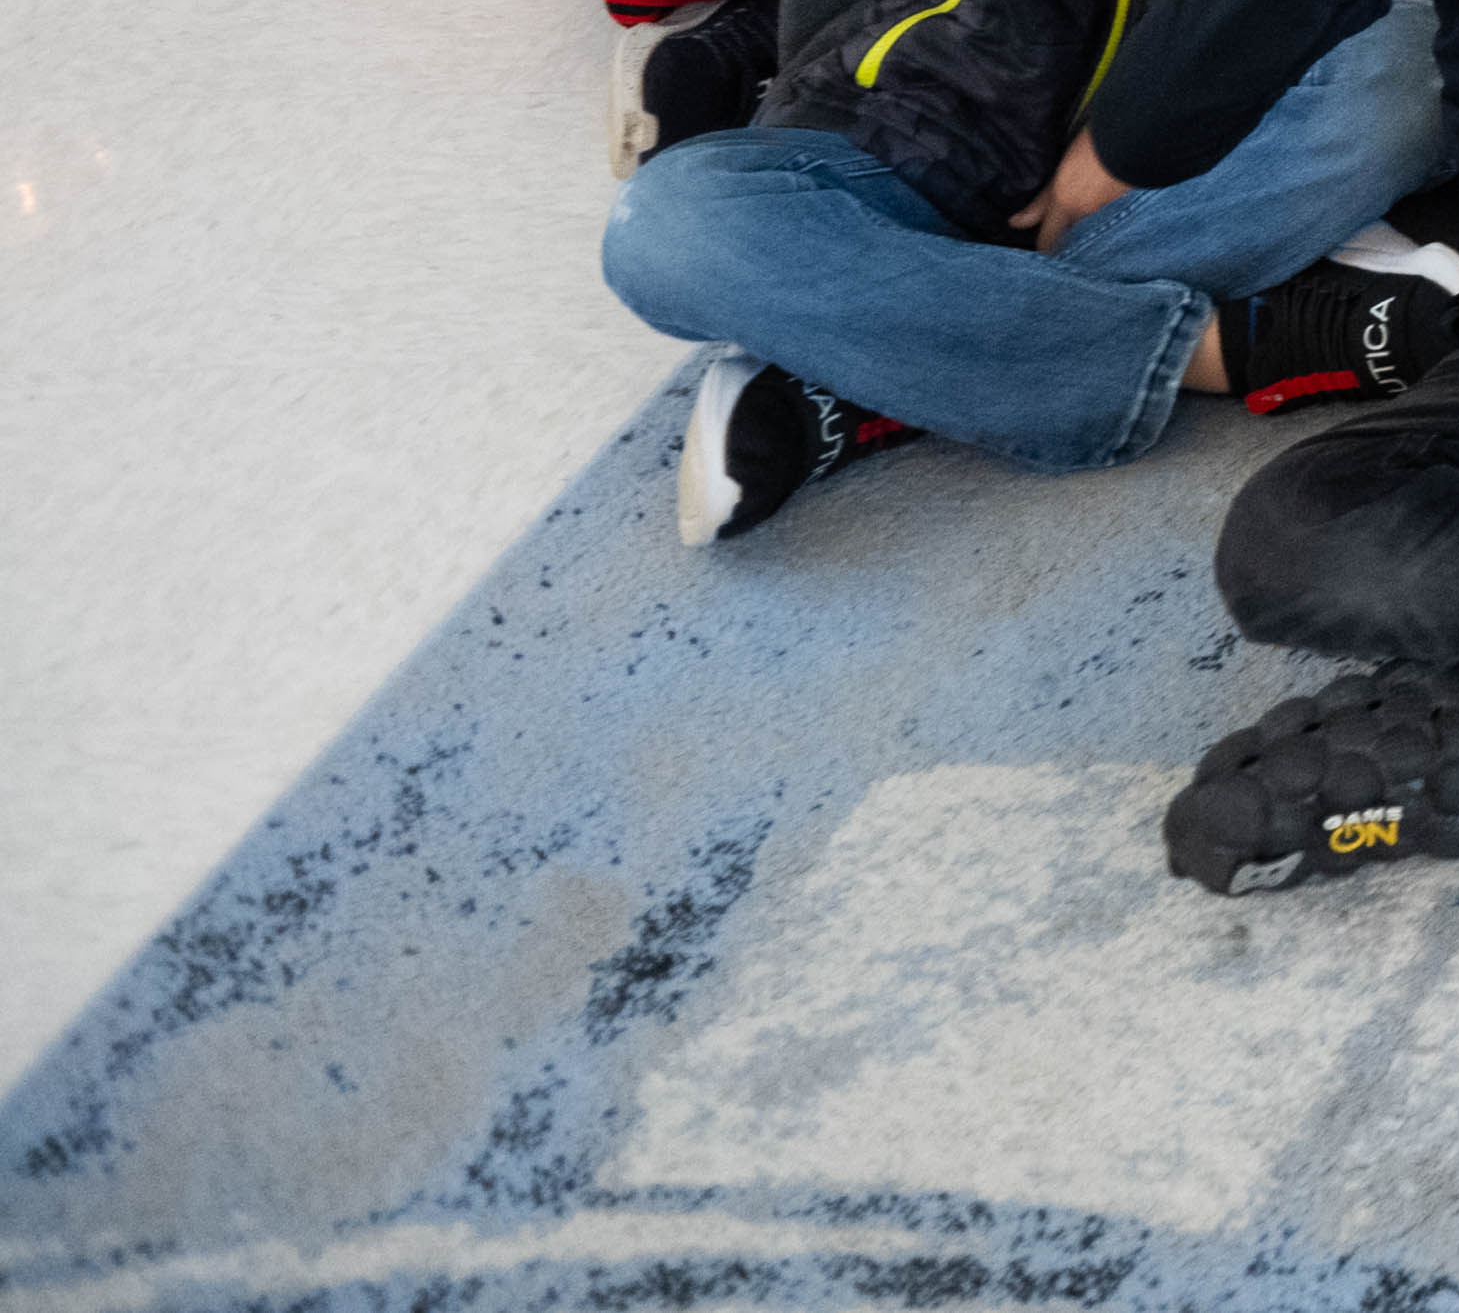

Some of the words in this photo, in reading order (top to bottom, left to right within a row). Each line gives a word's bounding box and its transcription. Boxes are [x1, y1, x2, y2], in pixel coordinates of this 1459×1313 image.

[1363, 295, 1408, 395] UTICA
[1322, 805, 1405, 832] GAME
[1329, 821, 1399, 854] ON
